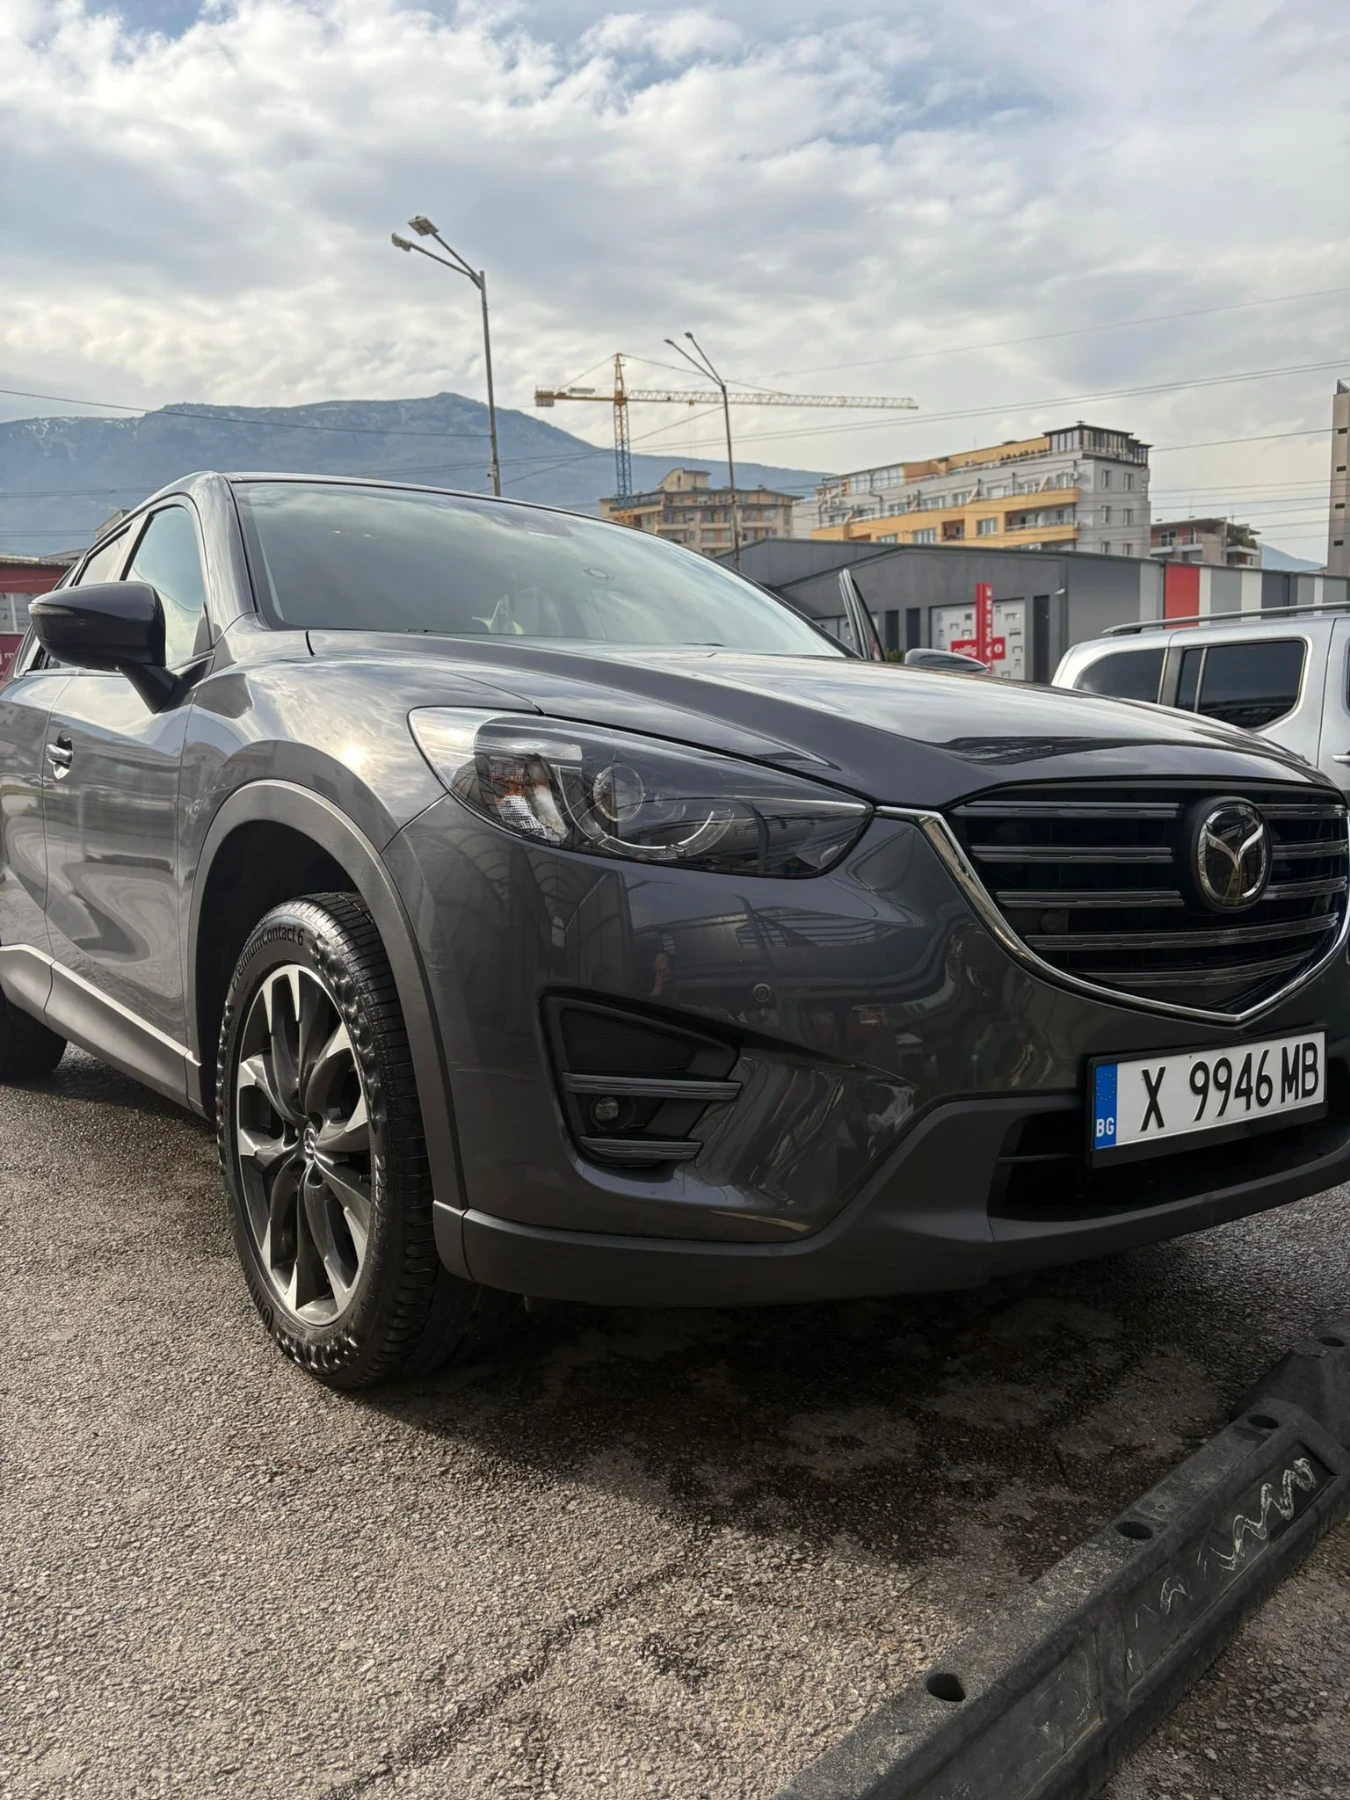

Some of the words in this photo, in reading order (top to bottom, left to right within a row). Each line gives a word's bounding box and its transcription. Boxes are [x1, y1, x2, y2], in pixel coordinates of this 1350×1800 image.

[297, 927, 305, 947] 6
[1140, 1066, 1166, 1132] X
[1189, 1049, 1273, 1122] 9946
[1280, 1041, 1319, 1104] MB
[1096, 1117, 1115, 1137] BG
